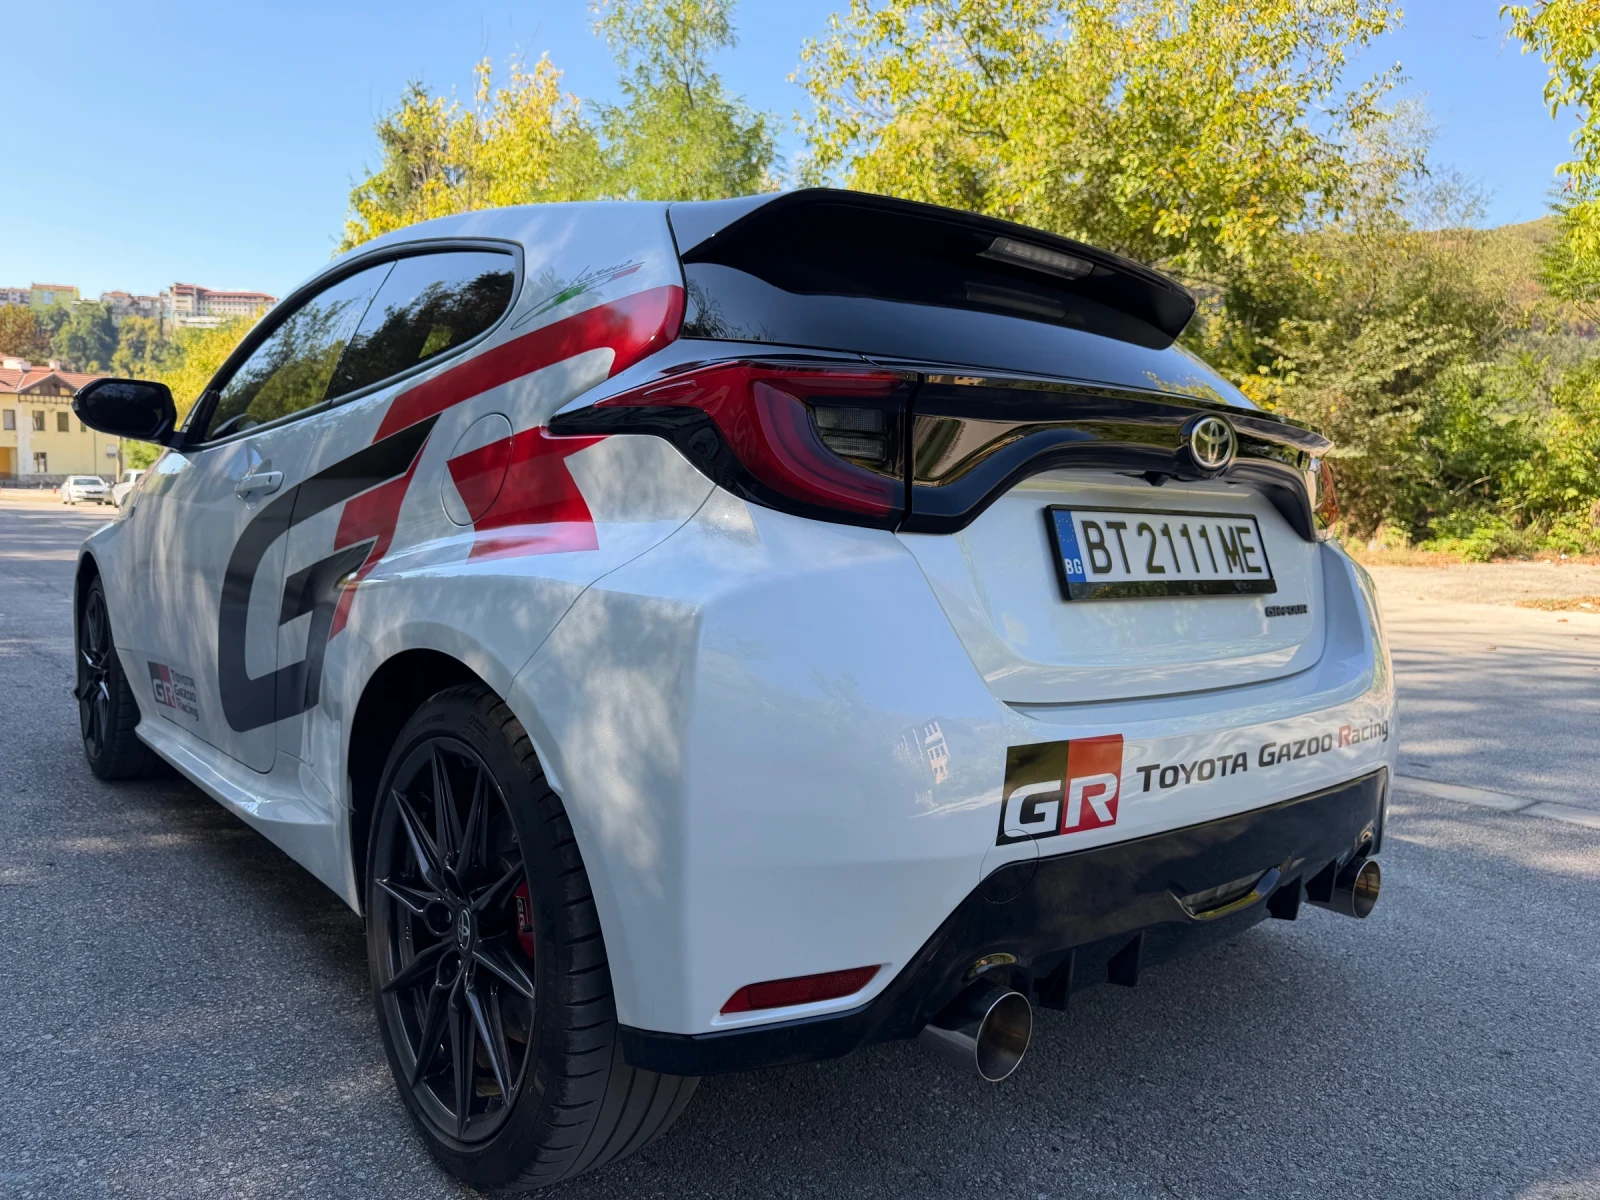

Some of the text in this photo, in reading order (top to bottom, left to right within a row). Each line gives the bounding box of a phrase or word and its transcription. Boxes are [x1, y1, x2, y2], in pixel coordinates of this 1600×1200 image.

[1064, 558, 1083, 575] BG
[152, 678, 176, 708] GR
[1136, 718, 1389, 793] TOYOTA GAZOO Racing
[1003, 772, 1119, 838] GR
